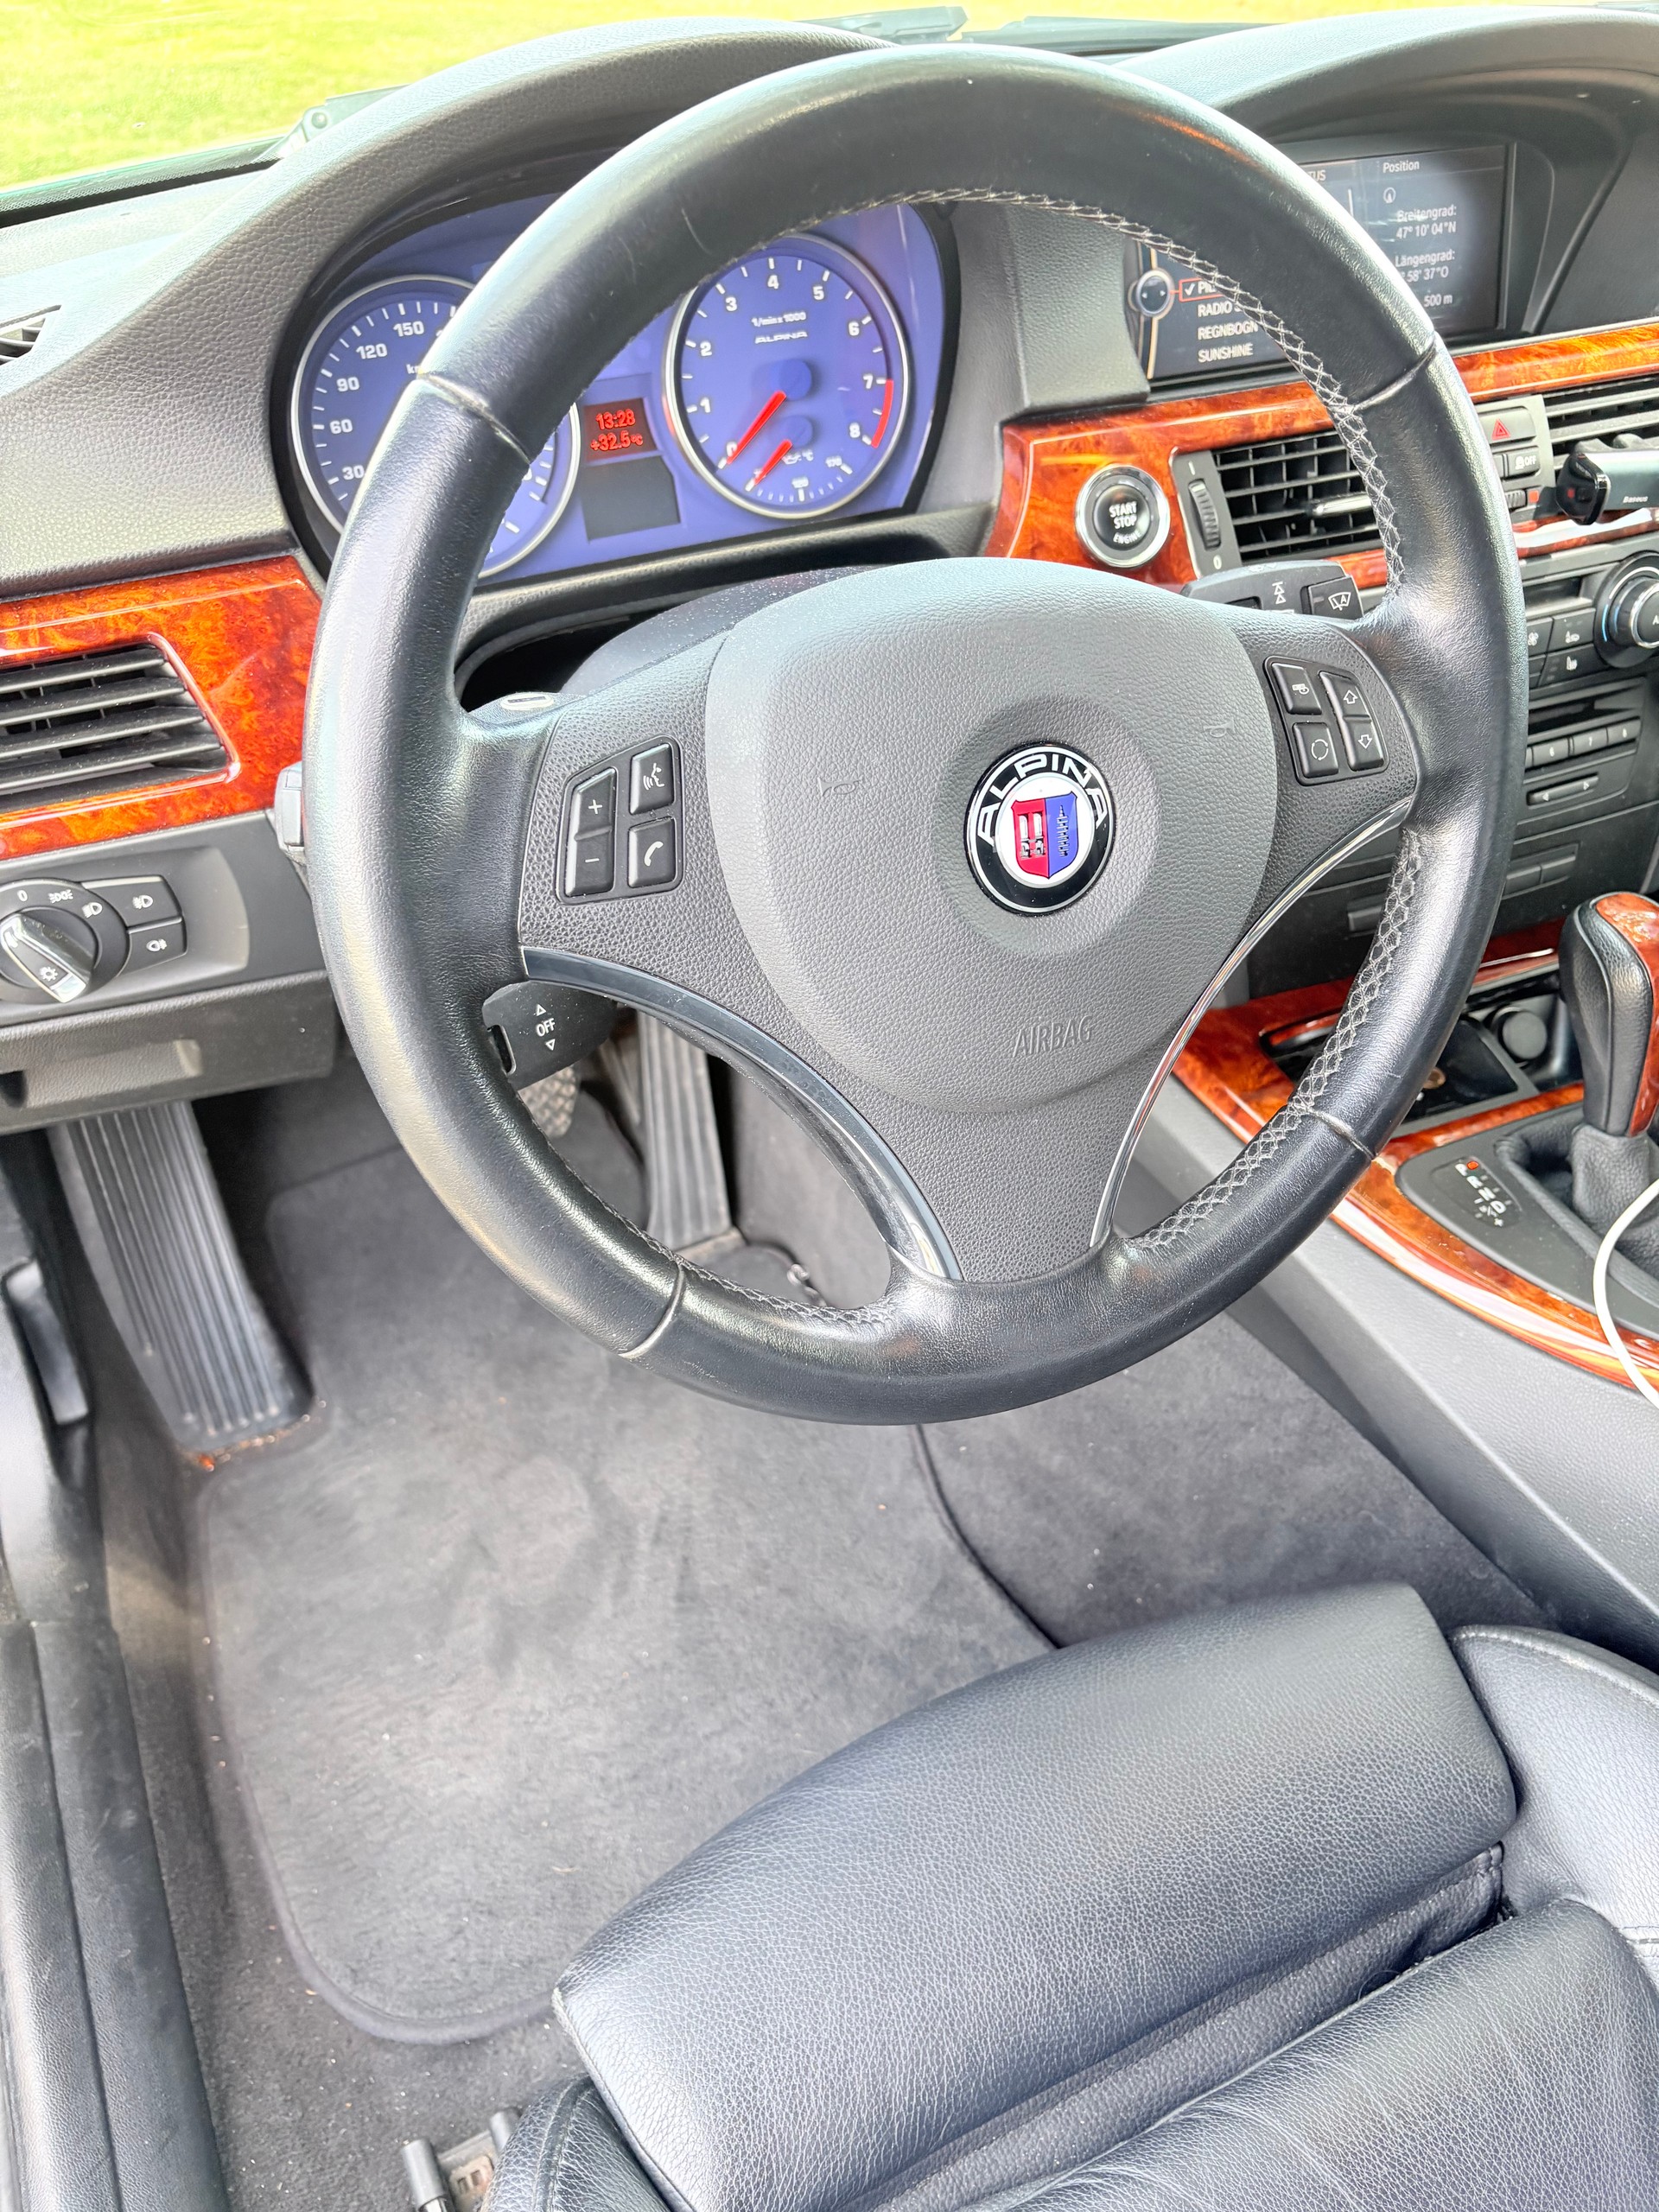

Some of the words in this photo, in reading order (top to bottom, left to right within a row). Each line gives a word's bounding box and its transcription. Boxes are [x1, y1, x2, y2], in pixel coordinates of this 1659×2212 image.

[1382, 161, 1421, 173] Position
[1396, 204, 1457, 223] Breitengrad:
[1395, 249, 1456, 268] Längengrad:
[767, 275, 779, 289] 4
[813, 285, 824, 301] 5
[726, 296, 738, 312] 3
[1198, 301, 1233, 317] RADIO
[393, 321, 425, 337] 150
[849, 321, 860, 336] 6
[1198, 320, 1259, 340] REGNBOGN
[356, 343, 388, 359] 120
[700, 342, 712, 357] 2
[1198, 342, 1254, 363] SUNSHINE
[336, 377, 359, 392] 90
[863, 374, 874, 389] 7
[700, 398, 711, 413] 1
[330, 419, 353, 434] 60
[595, 409, 635, 429] 13:28
[849, 423, 861, 438] 8
[1524, 455, 1536, 466] OFF
[342, 465, 365, 480] 30
[1109, 501, 1138, 518] START
[1114, 514, 1137, 530] STOP
[1113, 531, 1141, 544] ENGINE
[977, 753, 1109, 849] ALPINA
[17, 889, 28, 902] 0
[536, 1017, 556, 1037] OFF
[1013, 1014, 1092, 1058] AIRBAG
[1454, 1163, 1467, 1176] P
[1466, 1176, 1484, 1189] R
[1478, 1186, 1496, 1201] N
[1490, 1200, 1506, 1214] D
